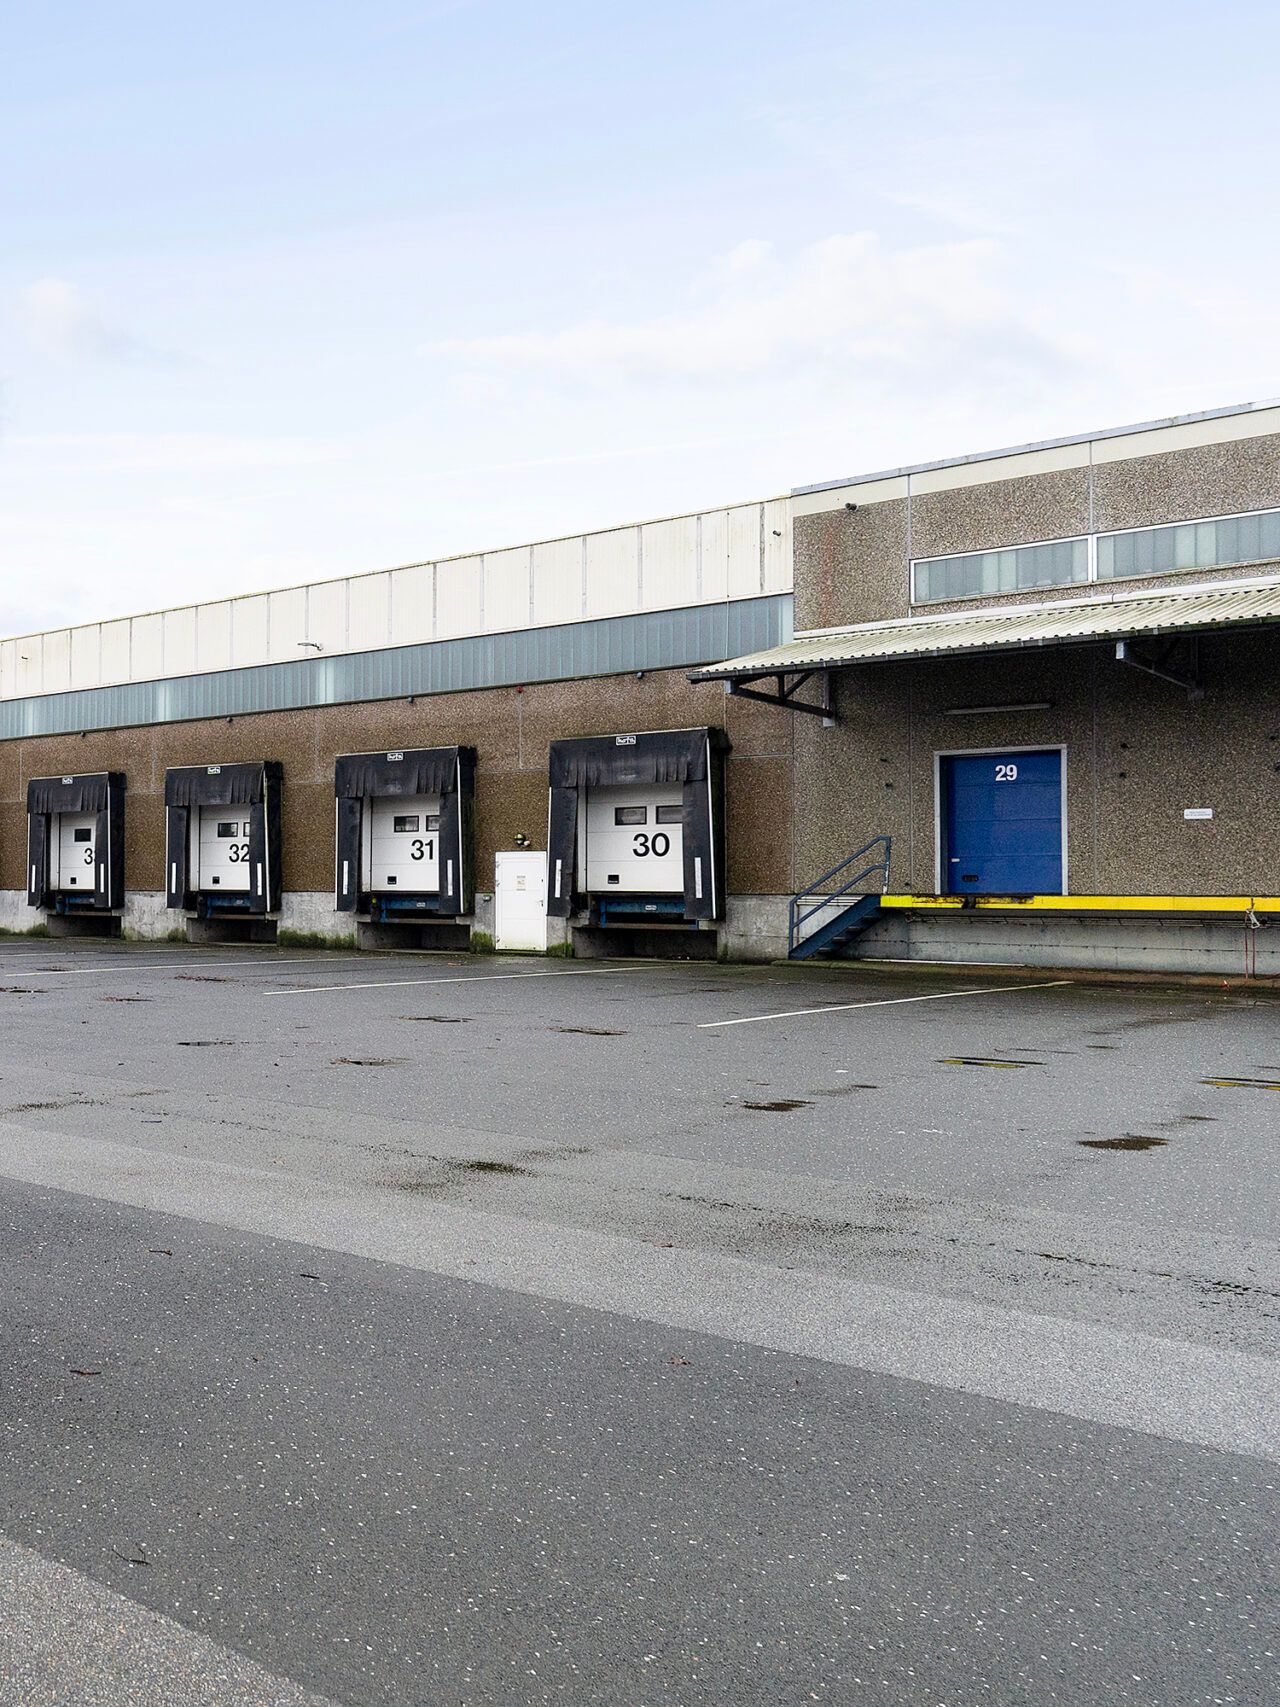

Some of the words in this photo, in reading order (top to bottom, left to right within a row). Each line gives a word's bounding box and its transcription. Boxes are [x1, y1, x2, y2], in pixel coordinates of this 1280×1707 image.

[995, 765, 1018, 781] 29
[228, 843, 250, 863] 32
[410, 839, 434, 861] 31
[632, 833, 670, 858] 30
